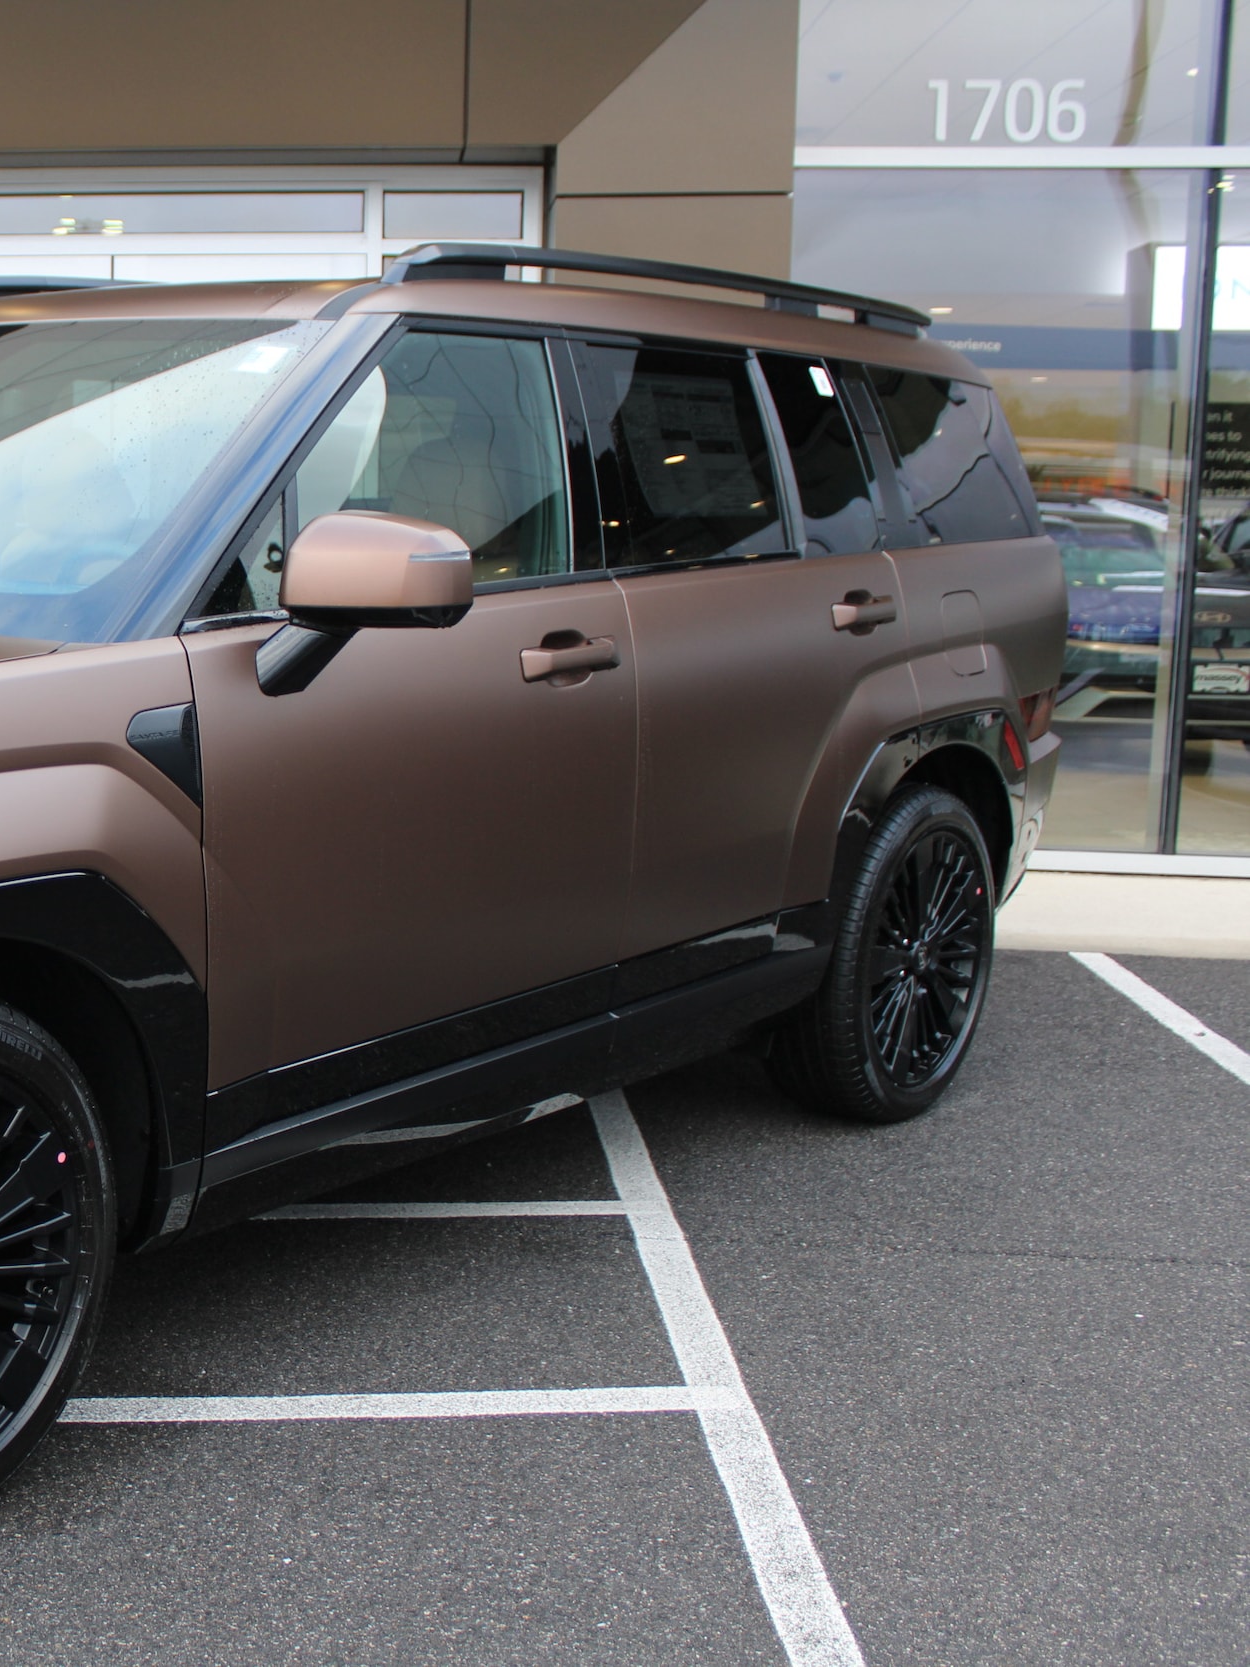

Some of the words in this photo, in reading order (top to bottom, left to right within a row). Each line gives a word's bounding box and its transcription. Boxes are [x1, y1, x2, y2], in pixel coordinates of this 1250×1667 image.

[927, 78, 1086, 142] 1706
[1227, 430, 1243, 442] to
[1196, 674, 1242, 684] massey
